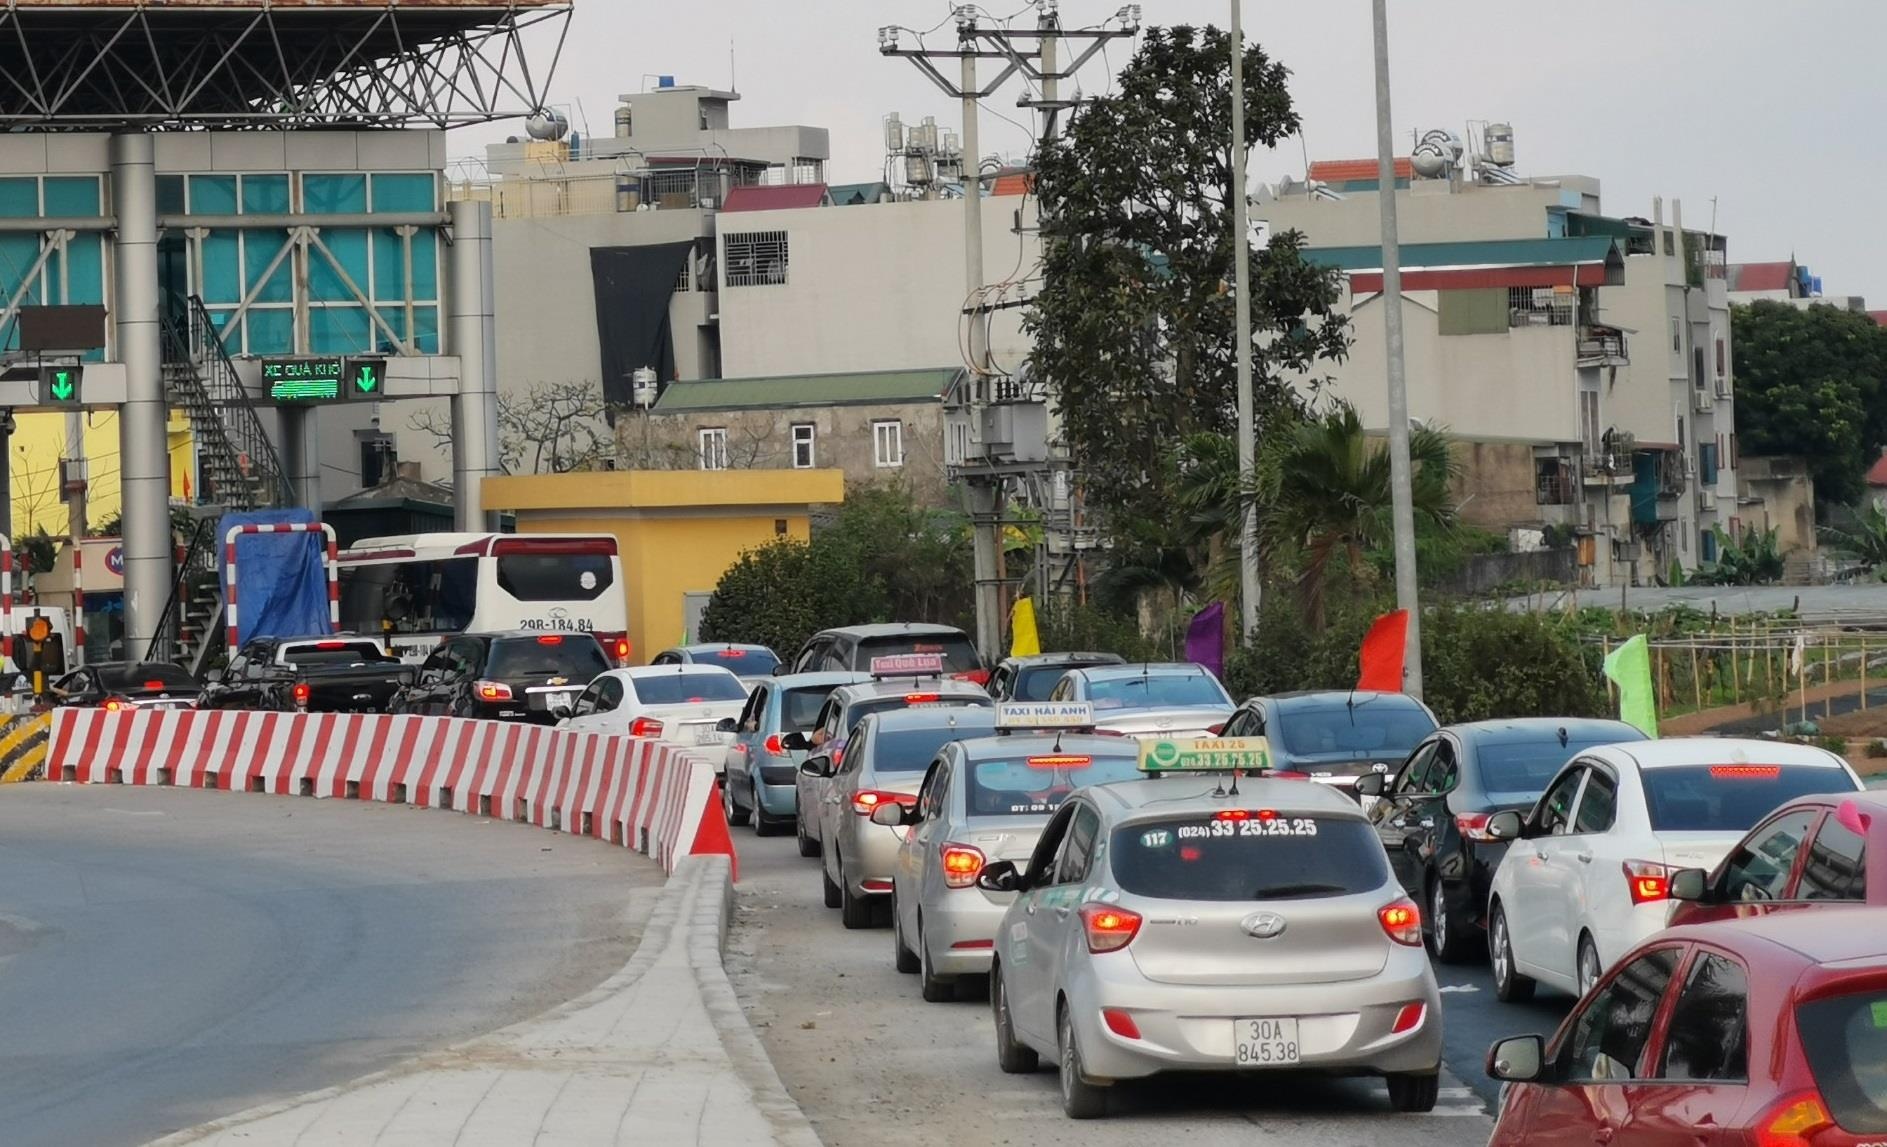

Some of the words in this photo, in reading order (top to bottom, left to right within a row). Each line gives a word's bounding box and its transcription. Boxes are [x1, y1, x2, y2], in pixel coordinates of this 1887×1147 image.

[1004, 707, 1030, 716] TAXI
[1060, 706, 1087, 715] ANH
[1194, 741, 1225, 750] TAXI
[1178, 826, 1211, 838] (024)
[1210, 820, 1235, 837] 33
[1239, 818, 1317, 837] 25.25.25
[1143, 831, 1169, 847] 117
[1249, 1020, 1283, 1041] 30A
[1238, 1041, 1298, 1063] 845.38
